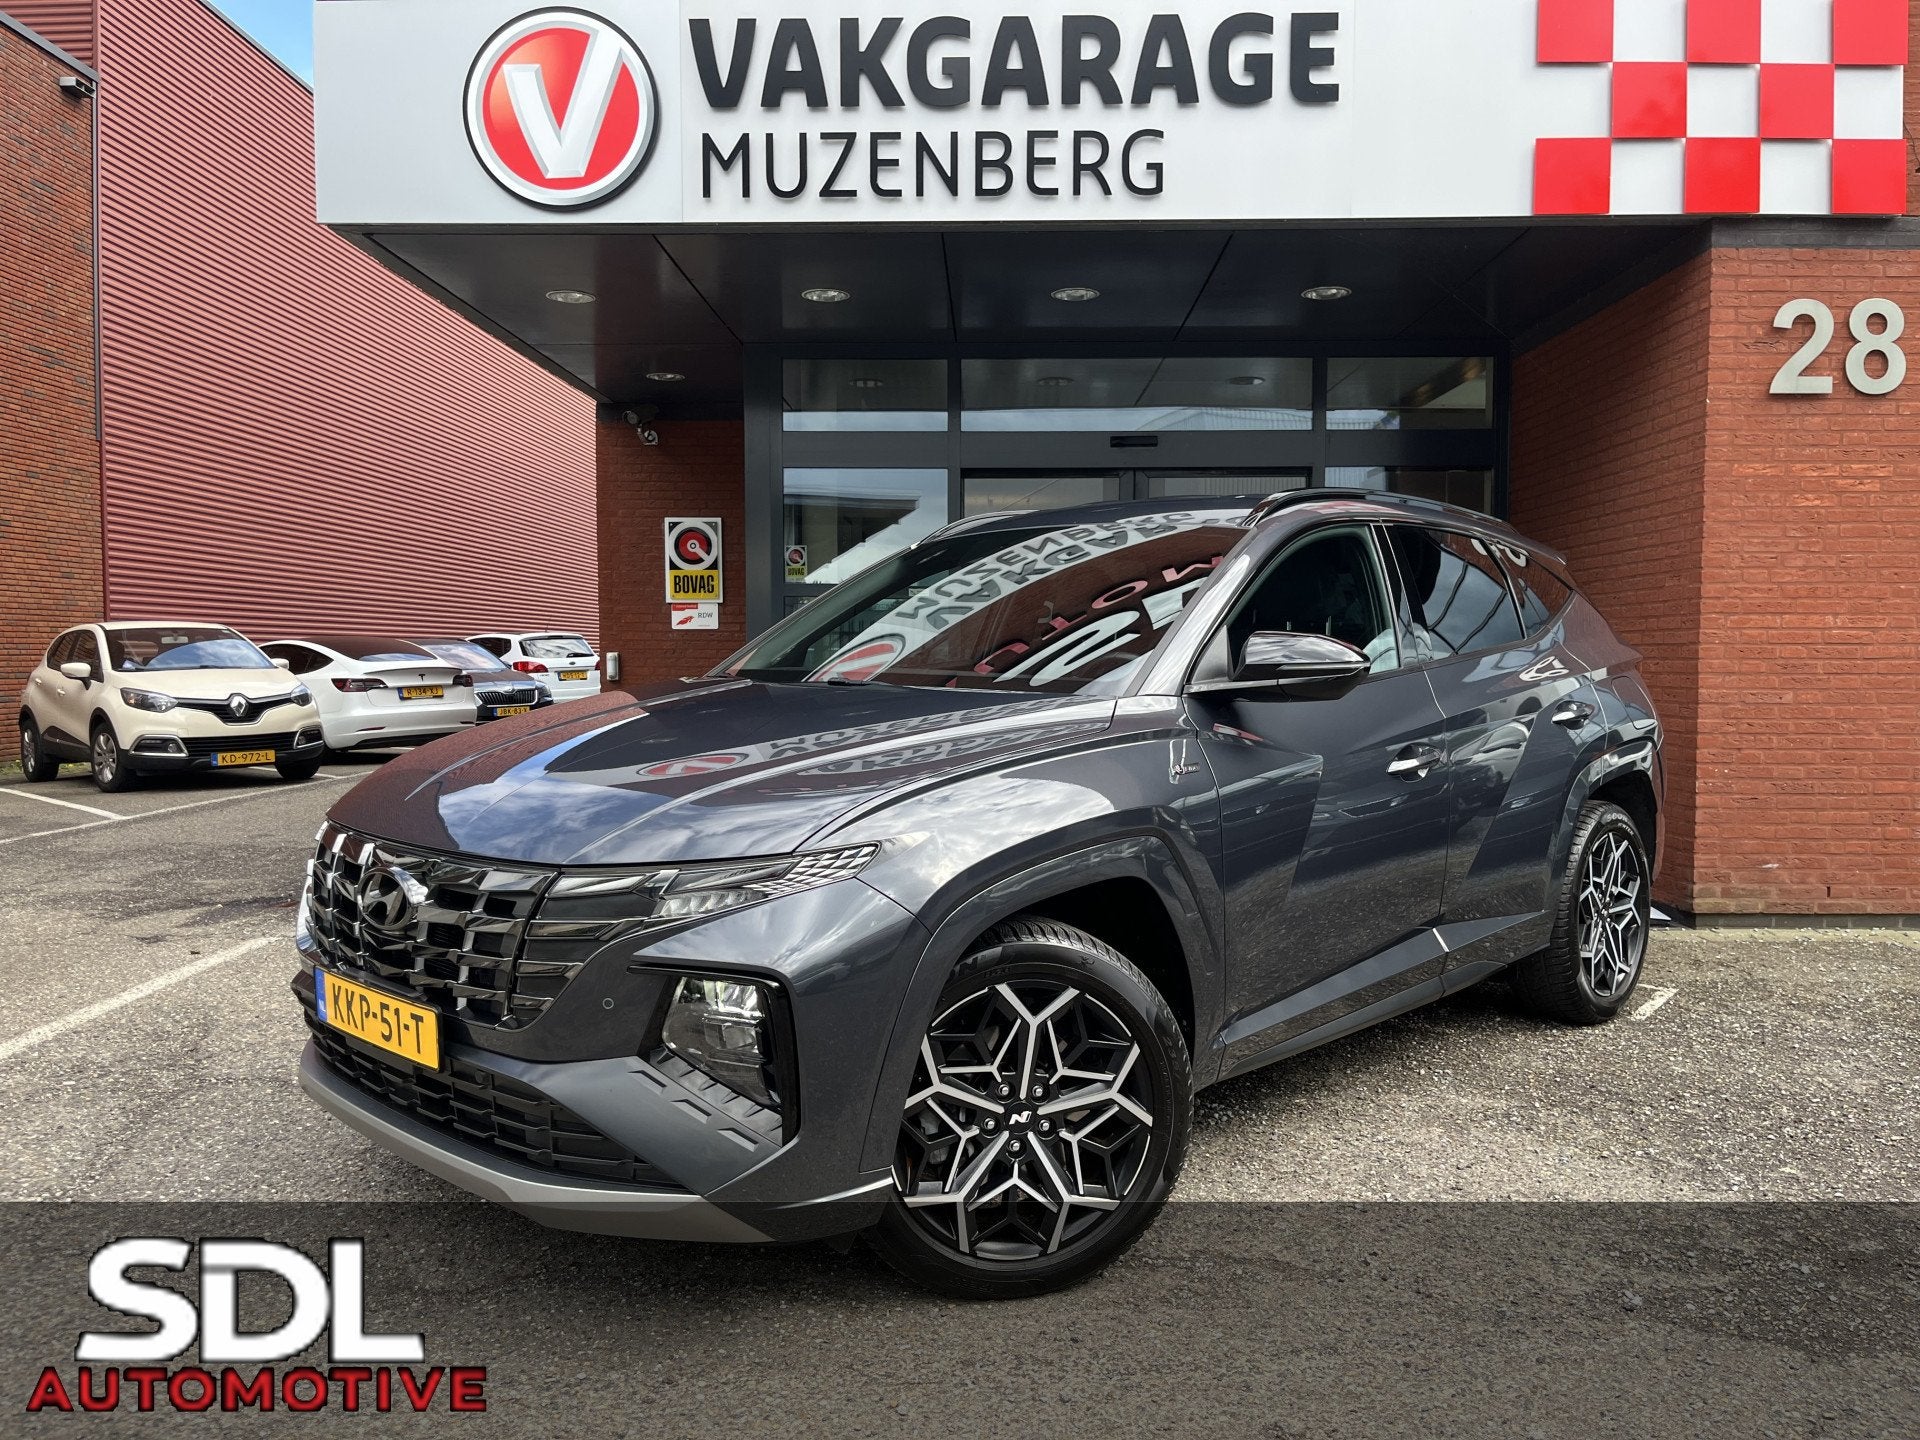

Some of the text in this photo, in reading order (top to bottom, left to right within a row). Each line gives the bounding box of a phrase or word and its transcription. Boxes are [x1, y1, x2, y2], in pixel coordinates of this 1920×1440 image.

[688, 11, 1339, 109] VAKGARAGE
[702, 128, 1165, 200] MUZENBERG
[1769, 297, 1907, 395] 28
[673, 574, 715, 594] BOVAG
[787, 567, 805, 576] BOVAG
[221, 752, 271, 764] KD-972-L
[332, 982, 424, 1054] KKP-51-T
